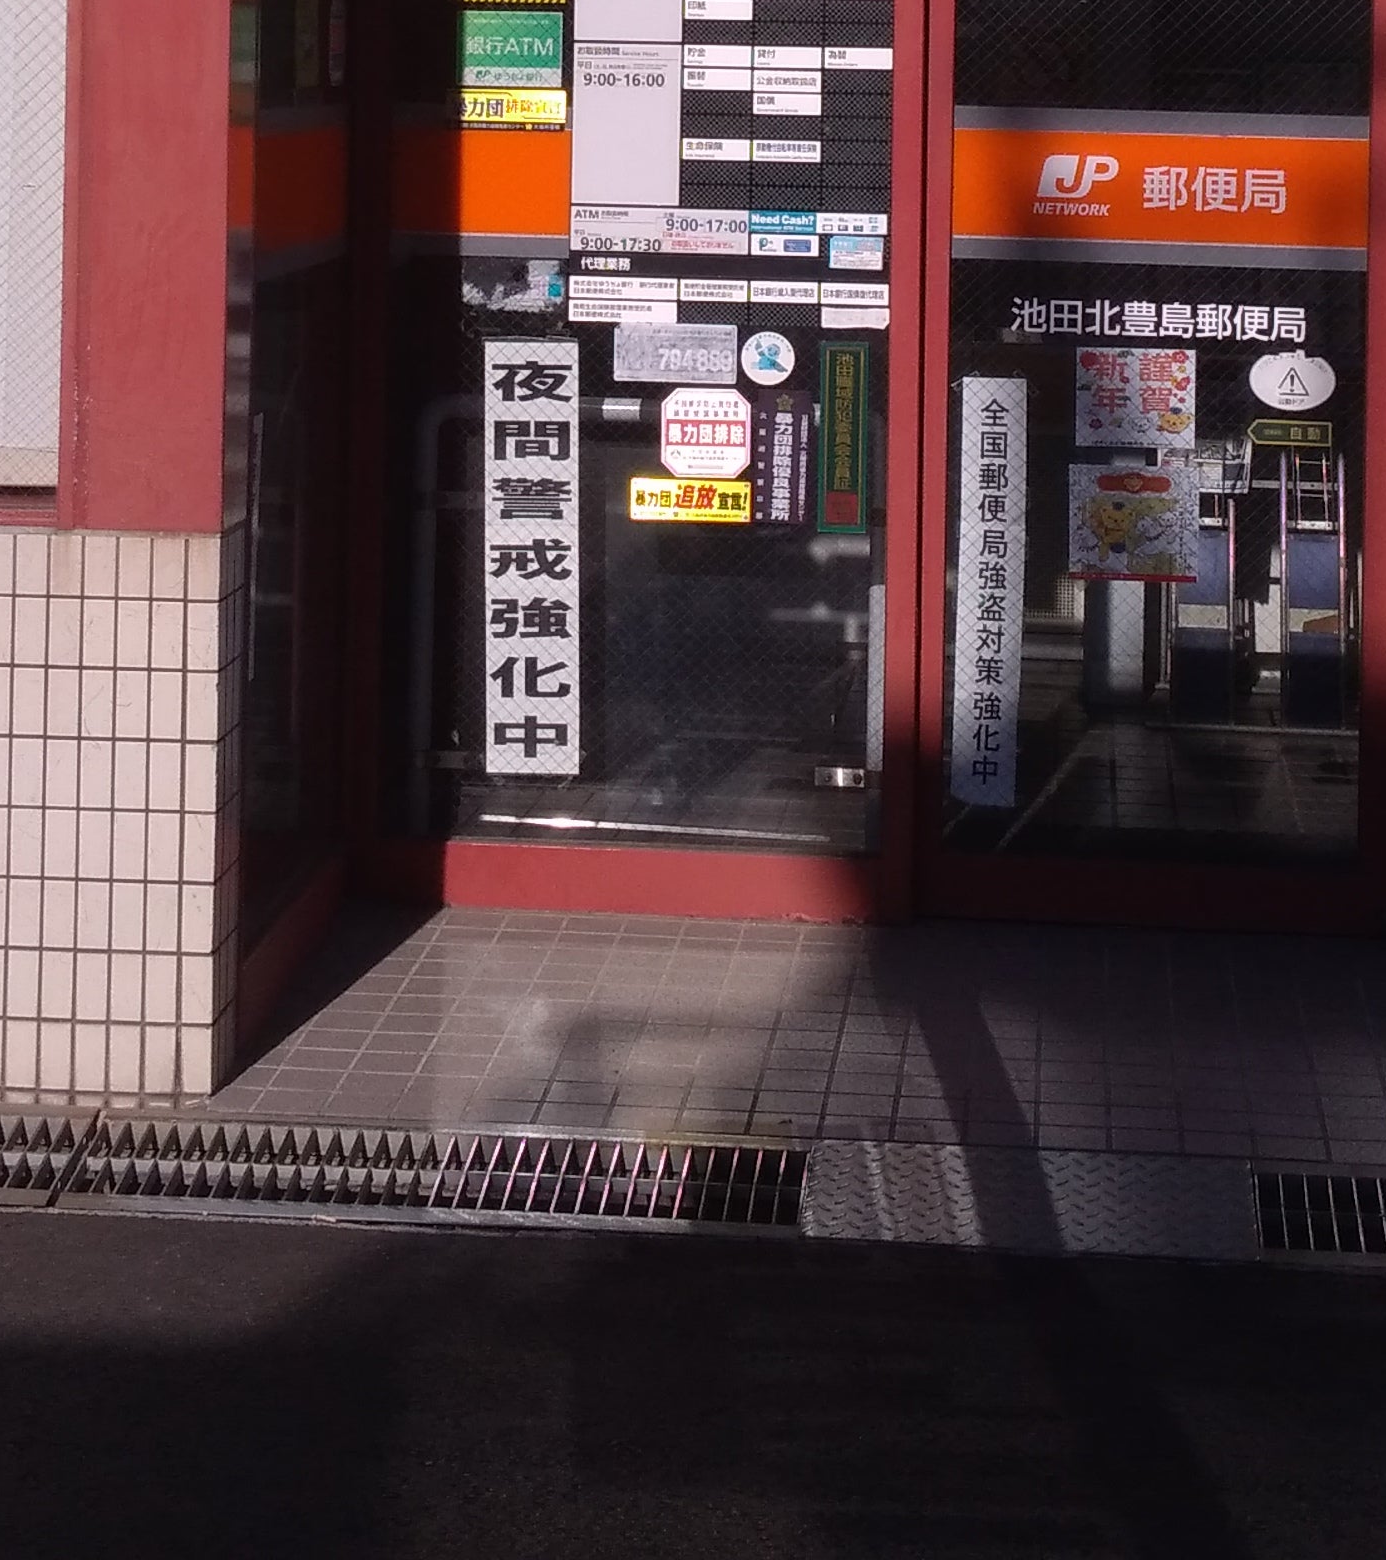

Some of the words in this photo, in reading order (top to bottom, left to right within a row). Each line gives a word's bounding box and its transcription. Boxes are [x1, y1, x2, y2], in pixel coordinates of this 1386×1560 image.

[583, 73, 665, 87] 9:00-16:00
[1037, 154, 1120, 199] JP
[1143, 165, 1288, 215] 郵便局
[573, 210, 599, 219] ATM
[1033, 201, 1111, 216] NETWORK
[665, 218, 746, 233] 9:00-17:00
[751, 214, 780, 225] Need
[782, 214, 814, 226] Cash?
[580, 237, 661, 251] 9:00-17:30
[581, 257, 631, 271] 代理業務
[1011, 297, 1308, 344] 池田北豊島郵便局
[1091, 352, 1128, 414] 新年
[1139, 352, 1174, 414] 謹賀
[668, 423, 745, 445] 暴力団排除
[489, 359, 574, 759] 夜間警戒強化中
[971, 398, 1009, 785] 全国郵便局強盗対策強化中
